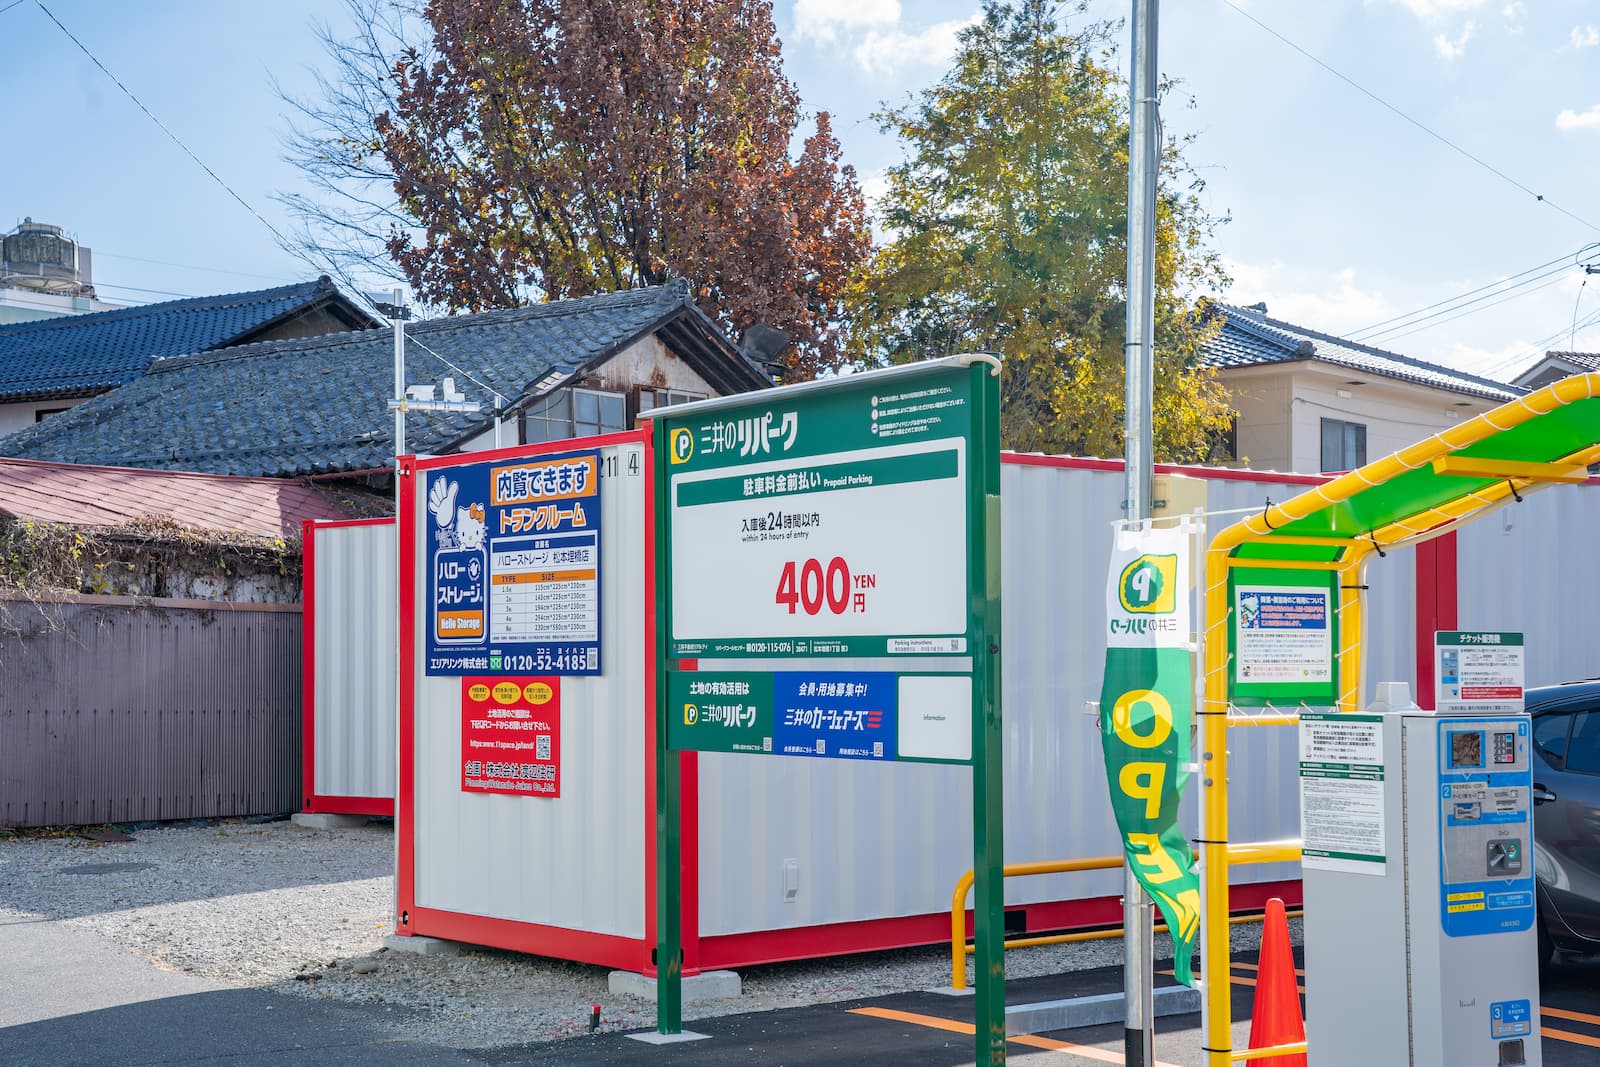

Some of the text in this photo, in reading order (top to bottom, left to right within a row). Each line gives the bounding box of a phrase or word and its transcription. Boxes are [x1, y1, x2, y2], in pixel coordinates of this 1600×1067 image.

[700, 410, 799, 456] 三井のリパーク
[678, 436, 689, 458] P
[629, 453, 639, 474] 4
[497, 463, 590, 502] 内覧できます
[743, 471, 873, 496] 駐車料金前払い Prepaid Parking
[499, 503, 587, 535] トランクルーム
[741, 510, 820, 533] 入庫後24時間以内
[742, 530, 809, 542] within 24 hours of entry
[498, 549, 590, 566] ハローストレージ 松本埋橋店
[438, 562, 466, 580] ハロー
[501, 573, 555, 583] TYPE SIZE
[775, 556, 851, 615] 400
[853, 574, 876, 589] YEN
[438, 583, 481, 604] ストレージ
[853, 593, 866, 613] 円
[441, 617, 481, 630] Hello Storage
[751, 642, 791, 653] 0120-115-076
[430, 658, 488, 670] エリアリンク株式会社
[503, 655, 586, 671] 0120-52-4185
[690, 682, 750, 696] 土地の有効活用は
[701, 704, 757, 728] 三井のリパーク
[784, 706, 869, 731] 三井のカーシェアーズ
[1494, 1008, 1501, 1019] 3
